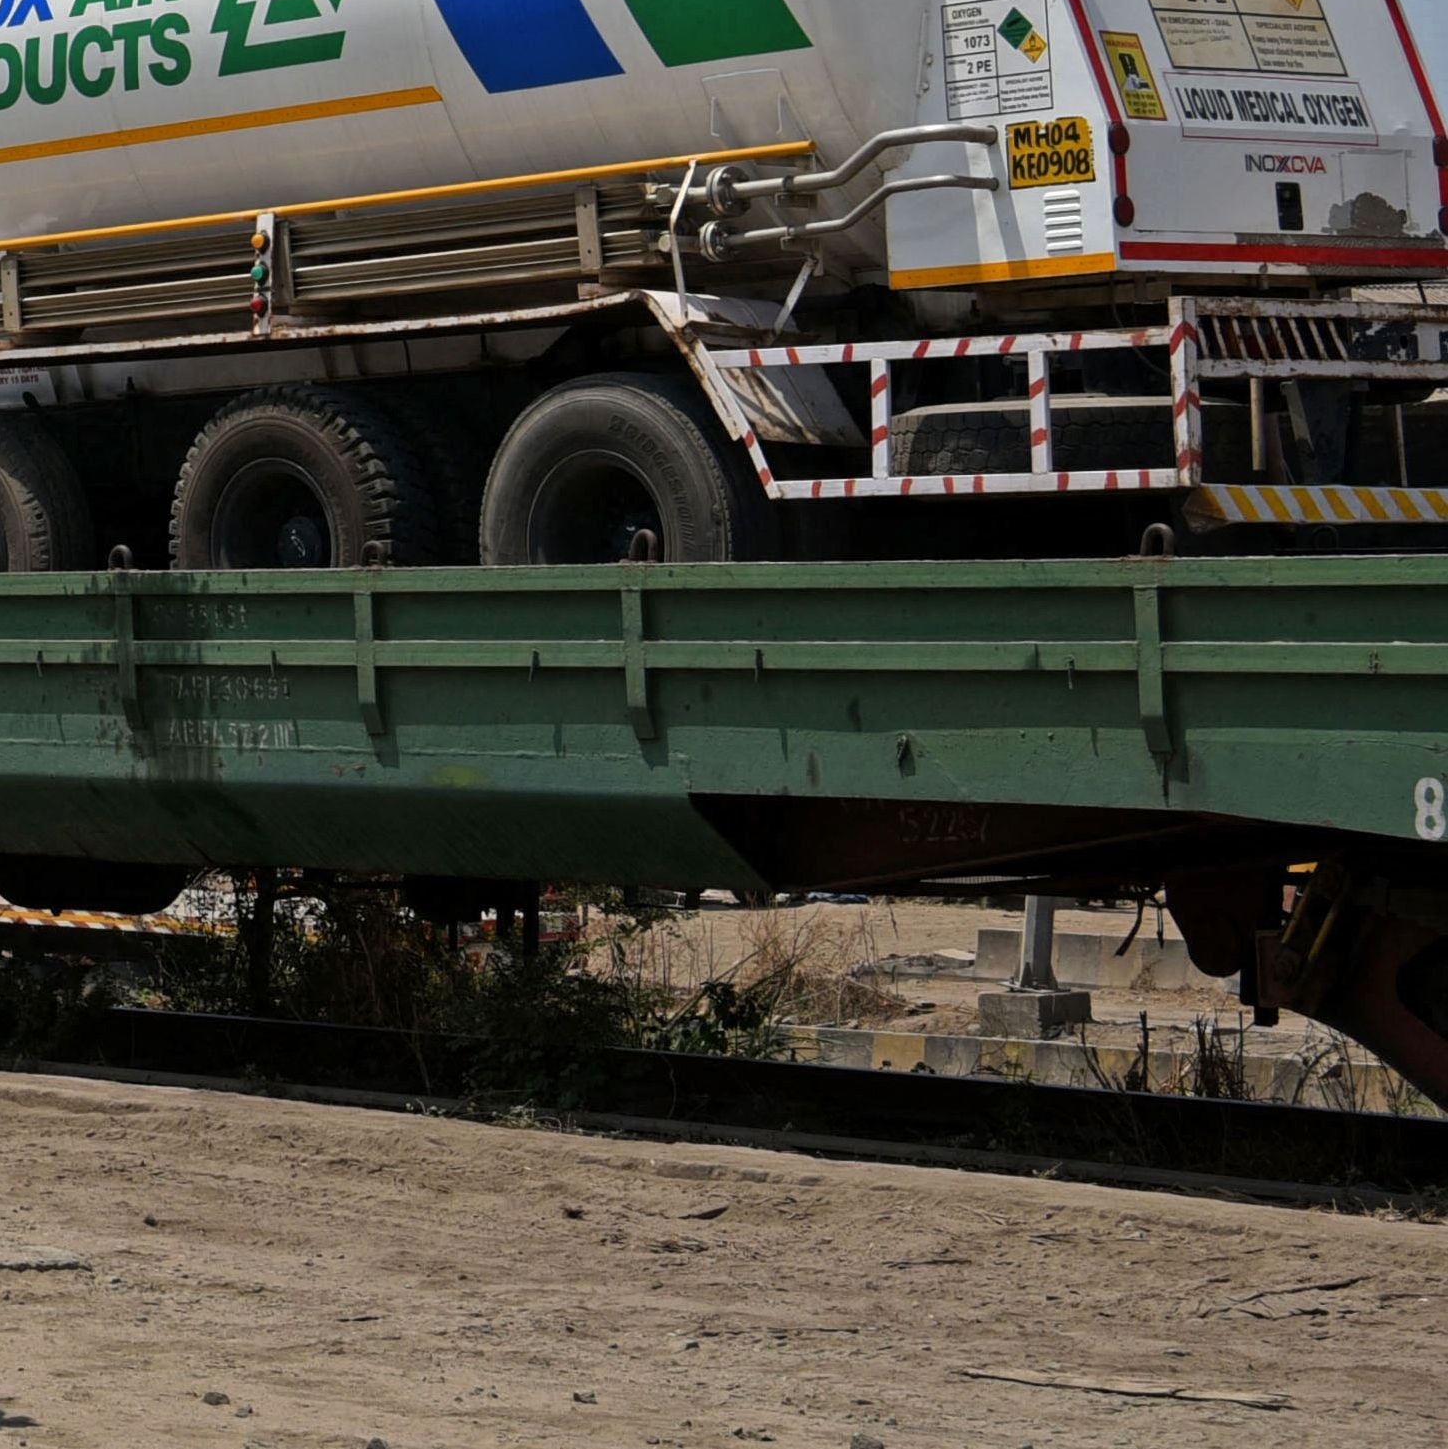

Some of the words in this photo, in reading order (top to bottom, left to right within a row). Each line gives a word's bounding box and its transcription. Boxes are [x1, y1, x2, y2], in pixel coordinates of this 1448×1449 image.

[952, 7, 982, 19] OXYGEN
[964, 34, 990, 49] 1073
[1175, 87, 1234, 122] LIQUID
[1231, 90, 1305, 125] MEDICAL
[1303, 93, 1369, 127] OXYGEN
[1013, 121, 1080, 149] MH04
[21, 374, 39, 384] DAYS
[1414, 777, 1446, 841] 8
